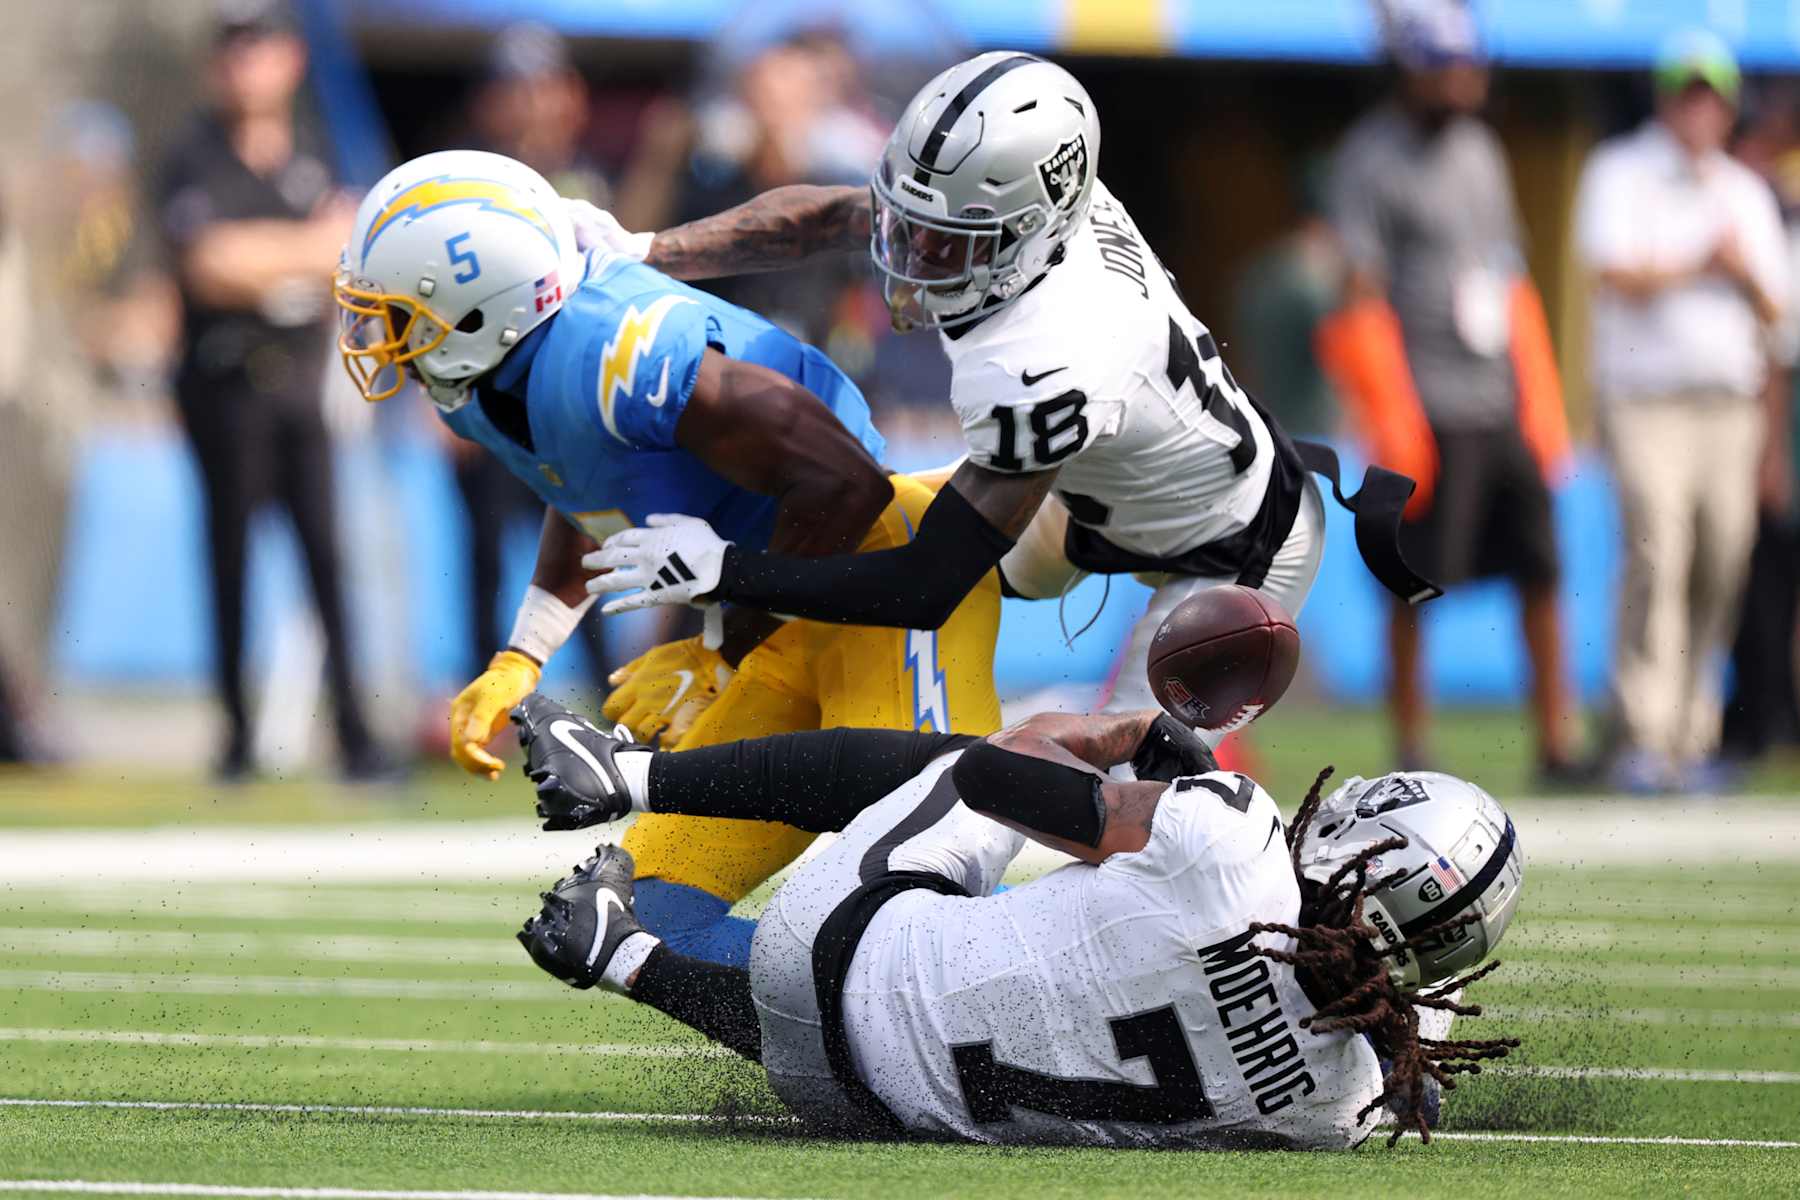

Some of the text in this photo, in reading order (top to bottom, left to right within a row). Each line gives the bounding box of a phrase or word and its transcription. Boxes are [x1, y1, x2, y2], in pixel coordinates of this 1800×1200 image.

[445, 231, 481, 285] 5
[1089, 200, 1149, 300] JONES
[990, 388, 1089, 471] 18
[1367, 910, 1411, 968] RAIDRS
[947, 1000, 1218, 1124] 7
[1196, 929, 1317, 1116] MOEHRIG
